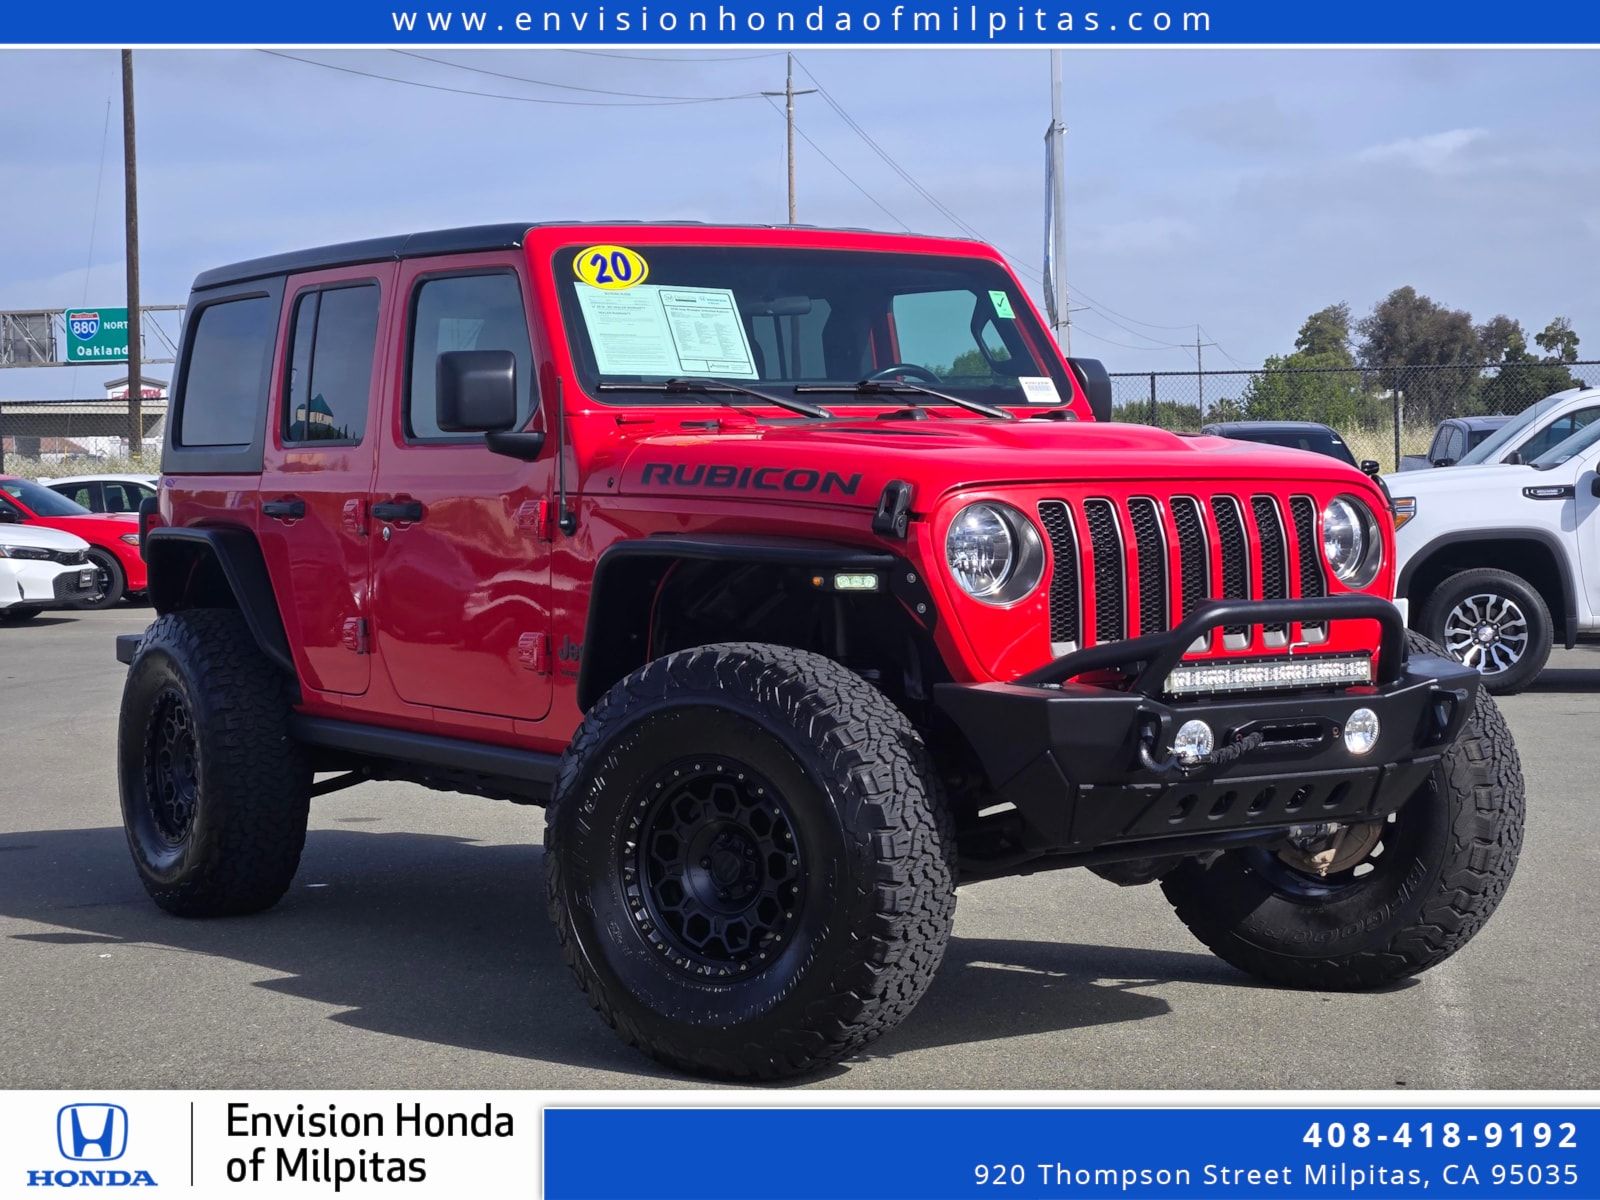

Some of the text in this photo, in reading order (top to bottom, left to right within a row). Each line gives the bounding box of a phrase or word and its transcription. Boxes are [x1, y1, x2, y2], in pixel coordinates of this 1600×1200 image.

[590, 251, 631, 284] 20
[73, 320, 128, 334] 880 NORT
[77, 345, 128, 356] Oakland
[641, 463, 864, 496] RUBICON
